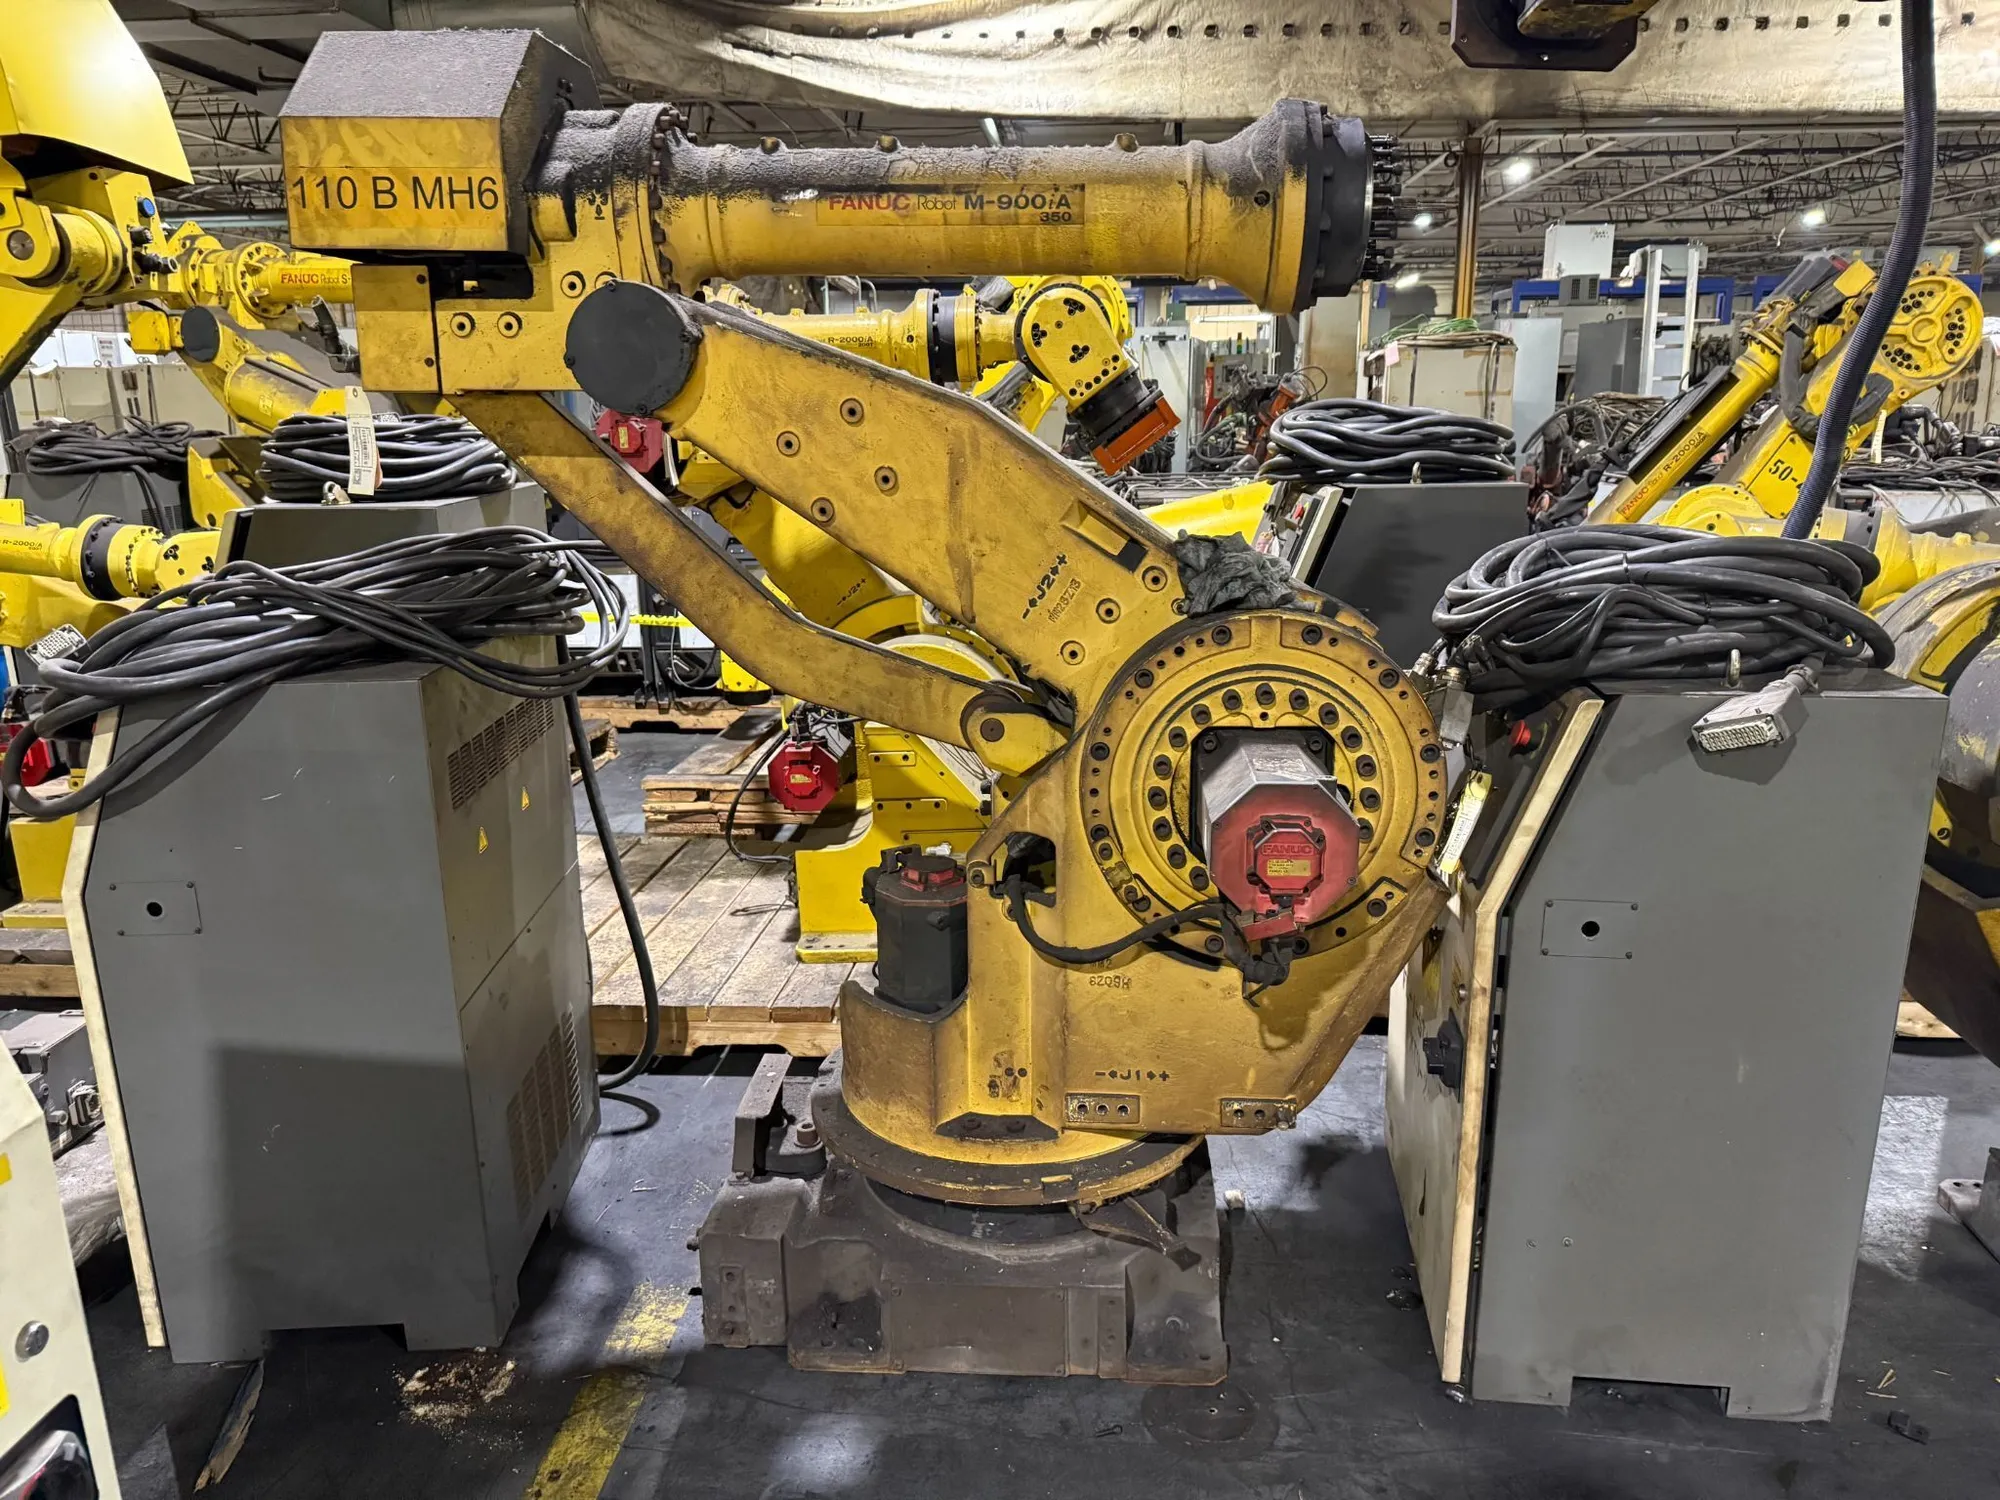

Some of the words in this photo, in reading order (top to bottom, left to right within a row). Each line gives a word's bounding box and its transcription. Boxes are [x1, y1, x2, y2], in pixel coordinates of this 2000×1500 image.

[292, 175, 358, 210] 110
[371, 176, 398, 209] B
[411, 176, 499, 210] MH6
[828, 193, 910, 210] FANUC
[917, 194, 958, 210] Robot
[1040, 211, 1072, 222] 350
[281, 273, 320, 284] FANUC
[1623, 486, 1649, 515] FANUC
[1263, 844, 1313, 855] FANUC
